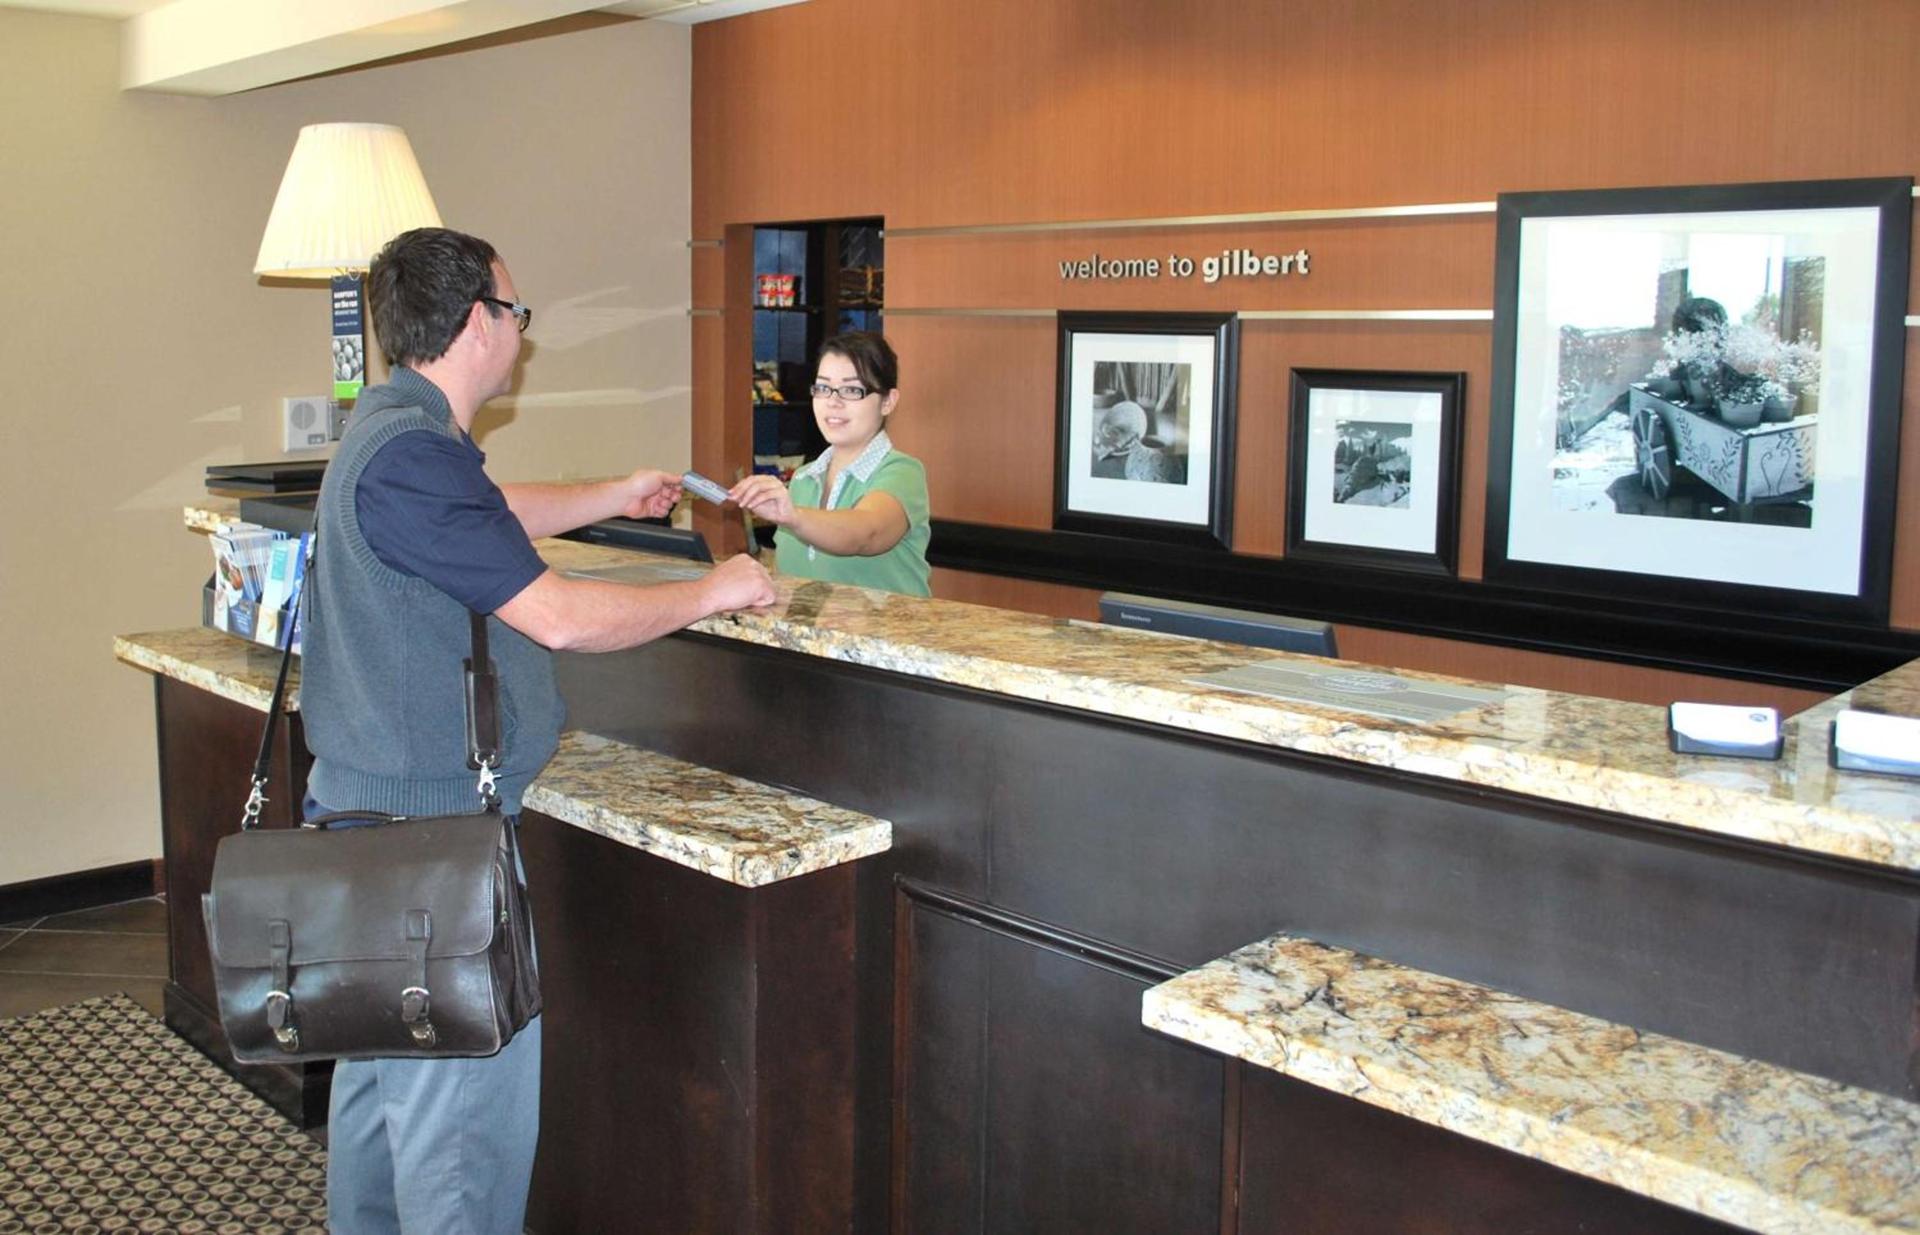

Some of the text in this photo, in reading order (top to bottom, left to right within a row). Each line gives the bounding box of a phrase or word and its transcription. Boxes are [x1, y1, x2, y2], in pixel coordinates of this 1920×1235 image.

[1059, 249, 1309, 283] welcome to gilbert
